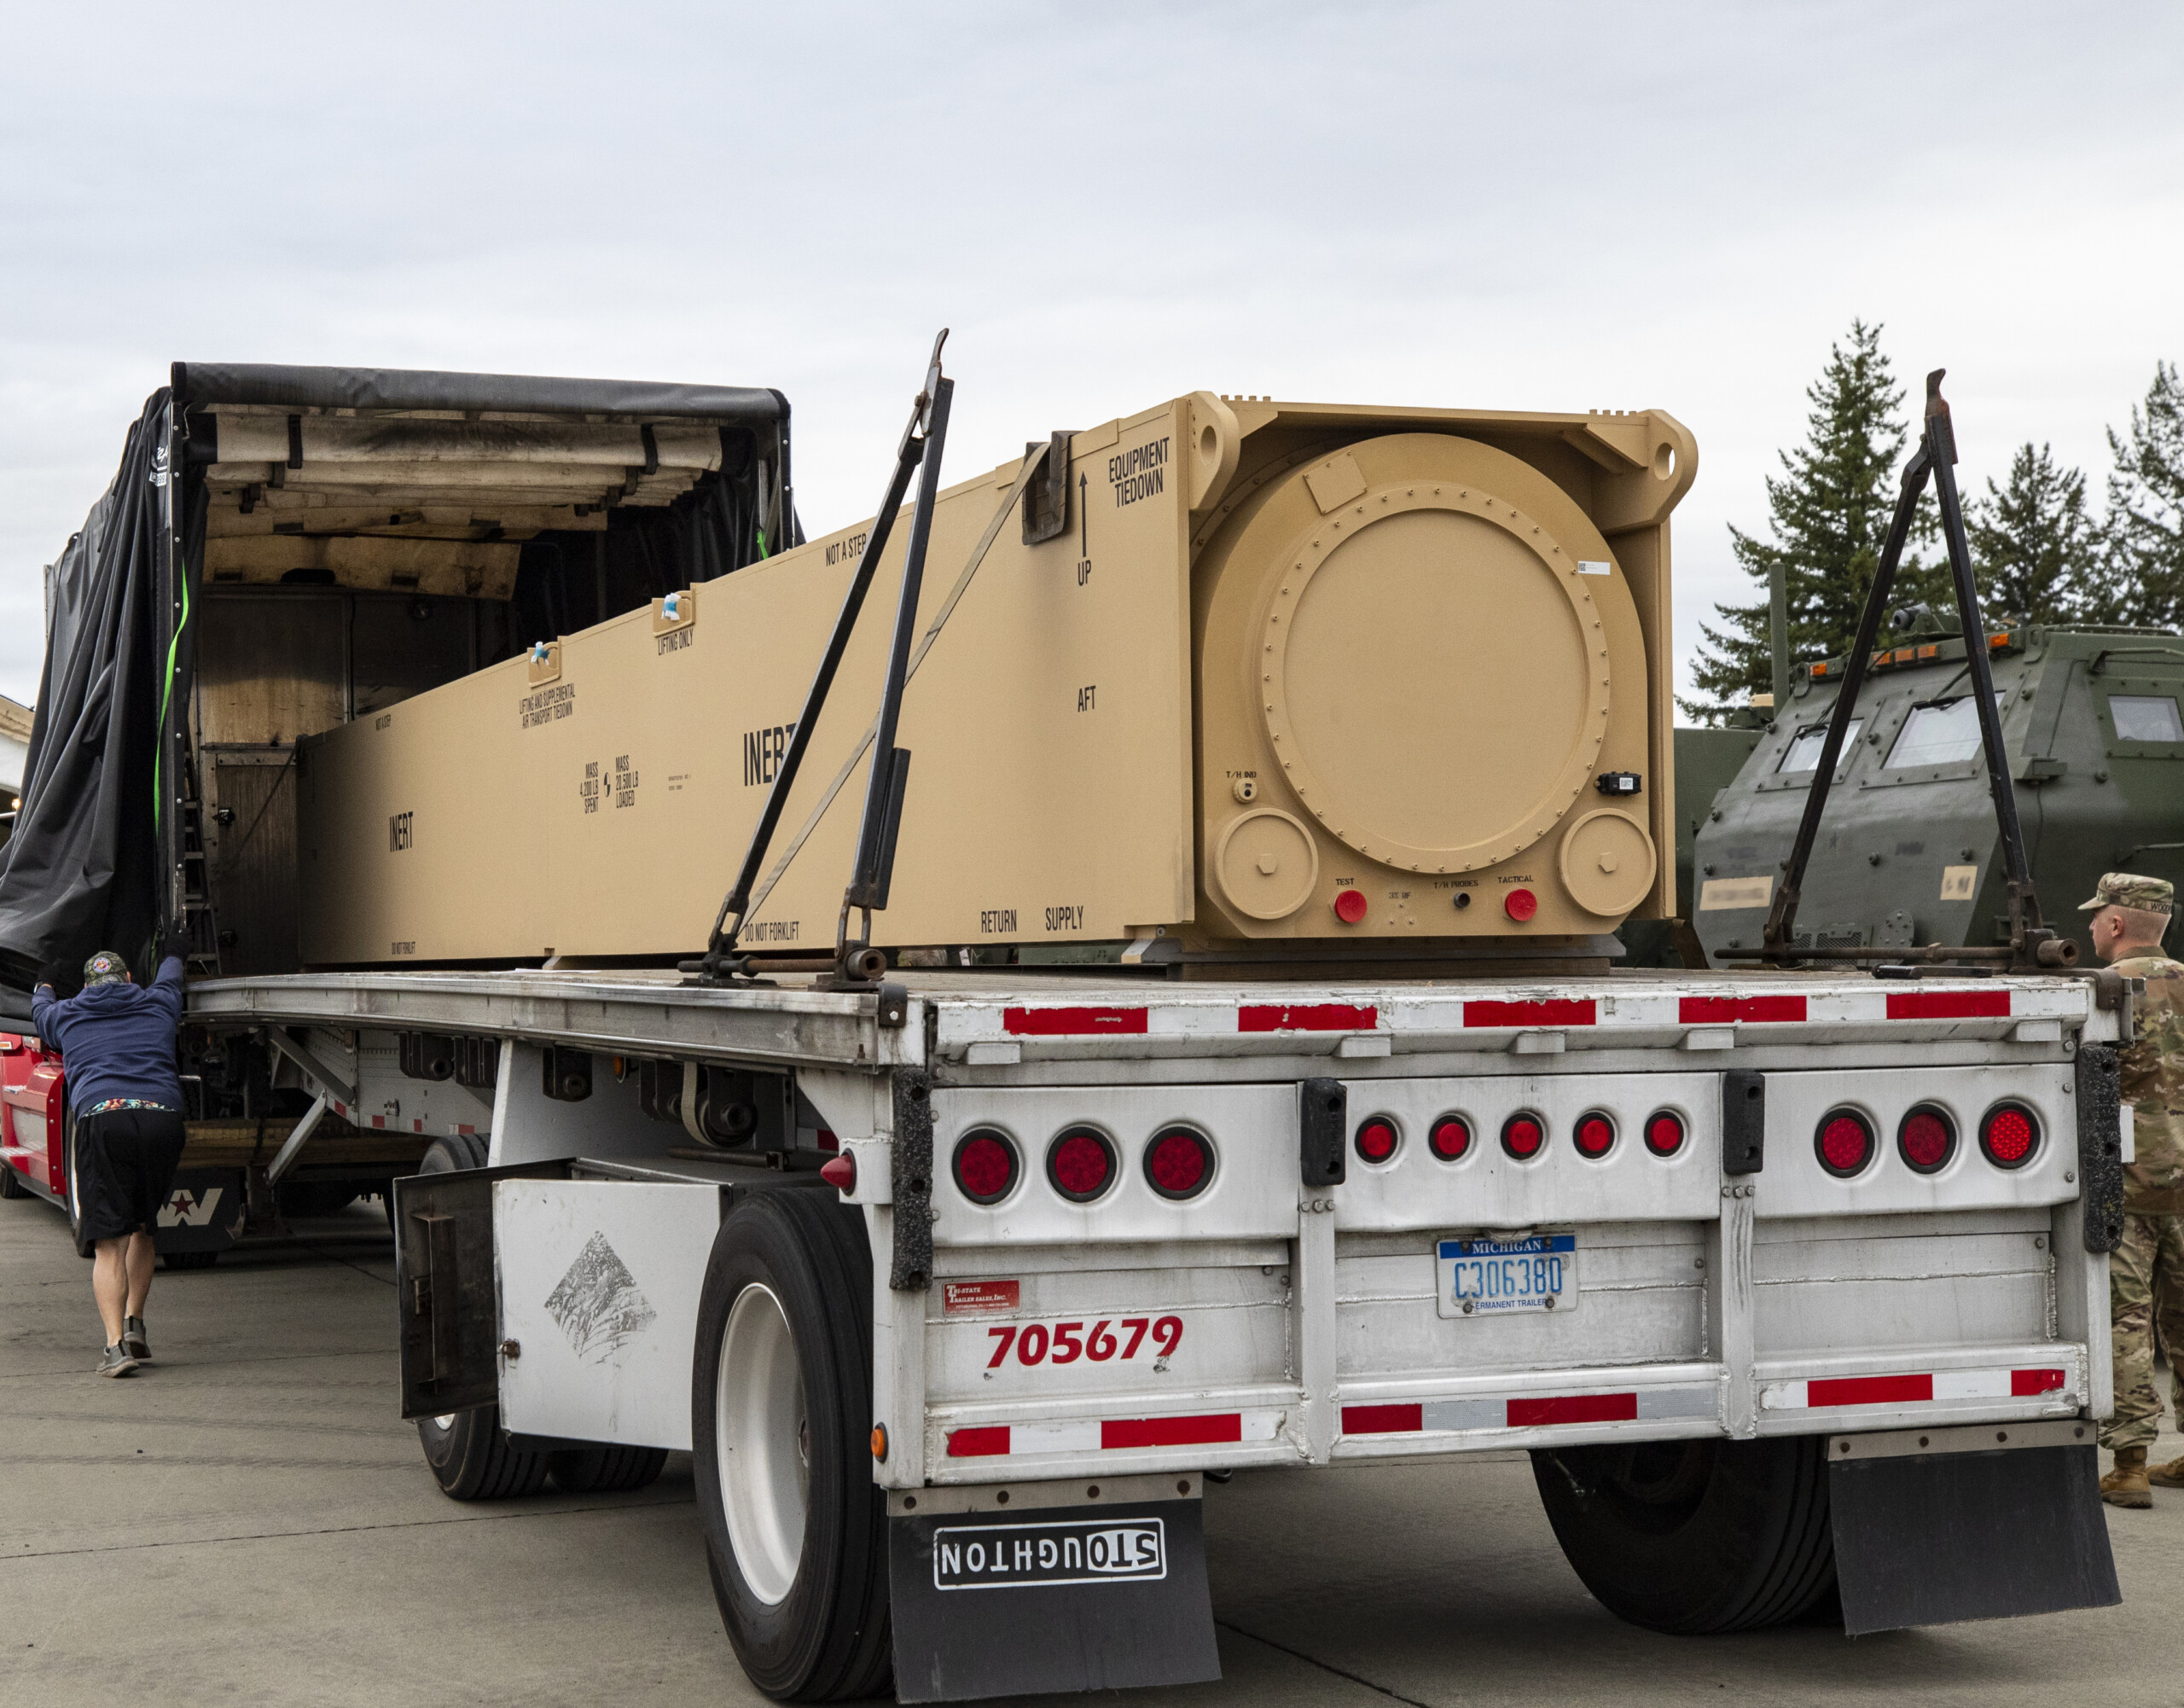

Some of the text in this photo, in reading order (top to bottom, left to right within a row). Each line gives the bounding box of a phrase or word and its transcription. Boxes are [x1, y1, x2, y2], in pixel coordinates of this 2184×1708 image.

[1108, 436, 1170, 484] EQUIPMENT
[1114, 467, 1164, 508] TIEDOWN
[825, 532, 867, 567] NOT A STEP
[1077, 559, 1092, 587] UP
[658, 627, 694, 656] LIFTING ONLY
[519, 682, 576, 715] LIFTING AND SUPPLEMENTAL
[1077, 685, 1096, 713] AFT
[521, 700, 573, 730] AIR TRANSPORT TIEDOWN
[585, 761, 599, 780] MASS
[615, 754, 630, 773] MASS
[632, 770, 639, 788] LB
[1225, 770, 1242, 779] T/H
[592, 779, 599, 796] LB
[584, 796, 599, 814] SPENT
[615, 789, 636, 809] LOADED
[389, 810, 414, 853] INERT
[1335, 877, 1355, 886] TEST
[1433, 880, 1479, 890] T/H PROBES
[1497, 874, 1535, 884] TACTICAL
[980, 905, 1084, 933] RETURN SUPPLY
[745, 921, 799, 943] DO NOT FORKLIFT
[1472, 1239, 1542, 1255] MICHIGAN
[946, 1284, 982, 1295] TRI-STATE
[948, 1293, 975, 1304] TRAILER
[1474, 1298, 1548, 1310] ERMANENT TRAILER
[986, 1315, 1184, 1368] 705679
[941, 1531, 1160, 1575] STOUGHTON
